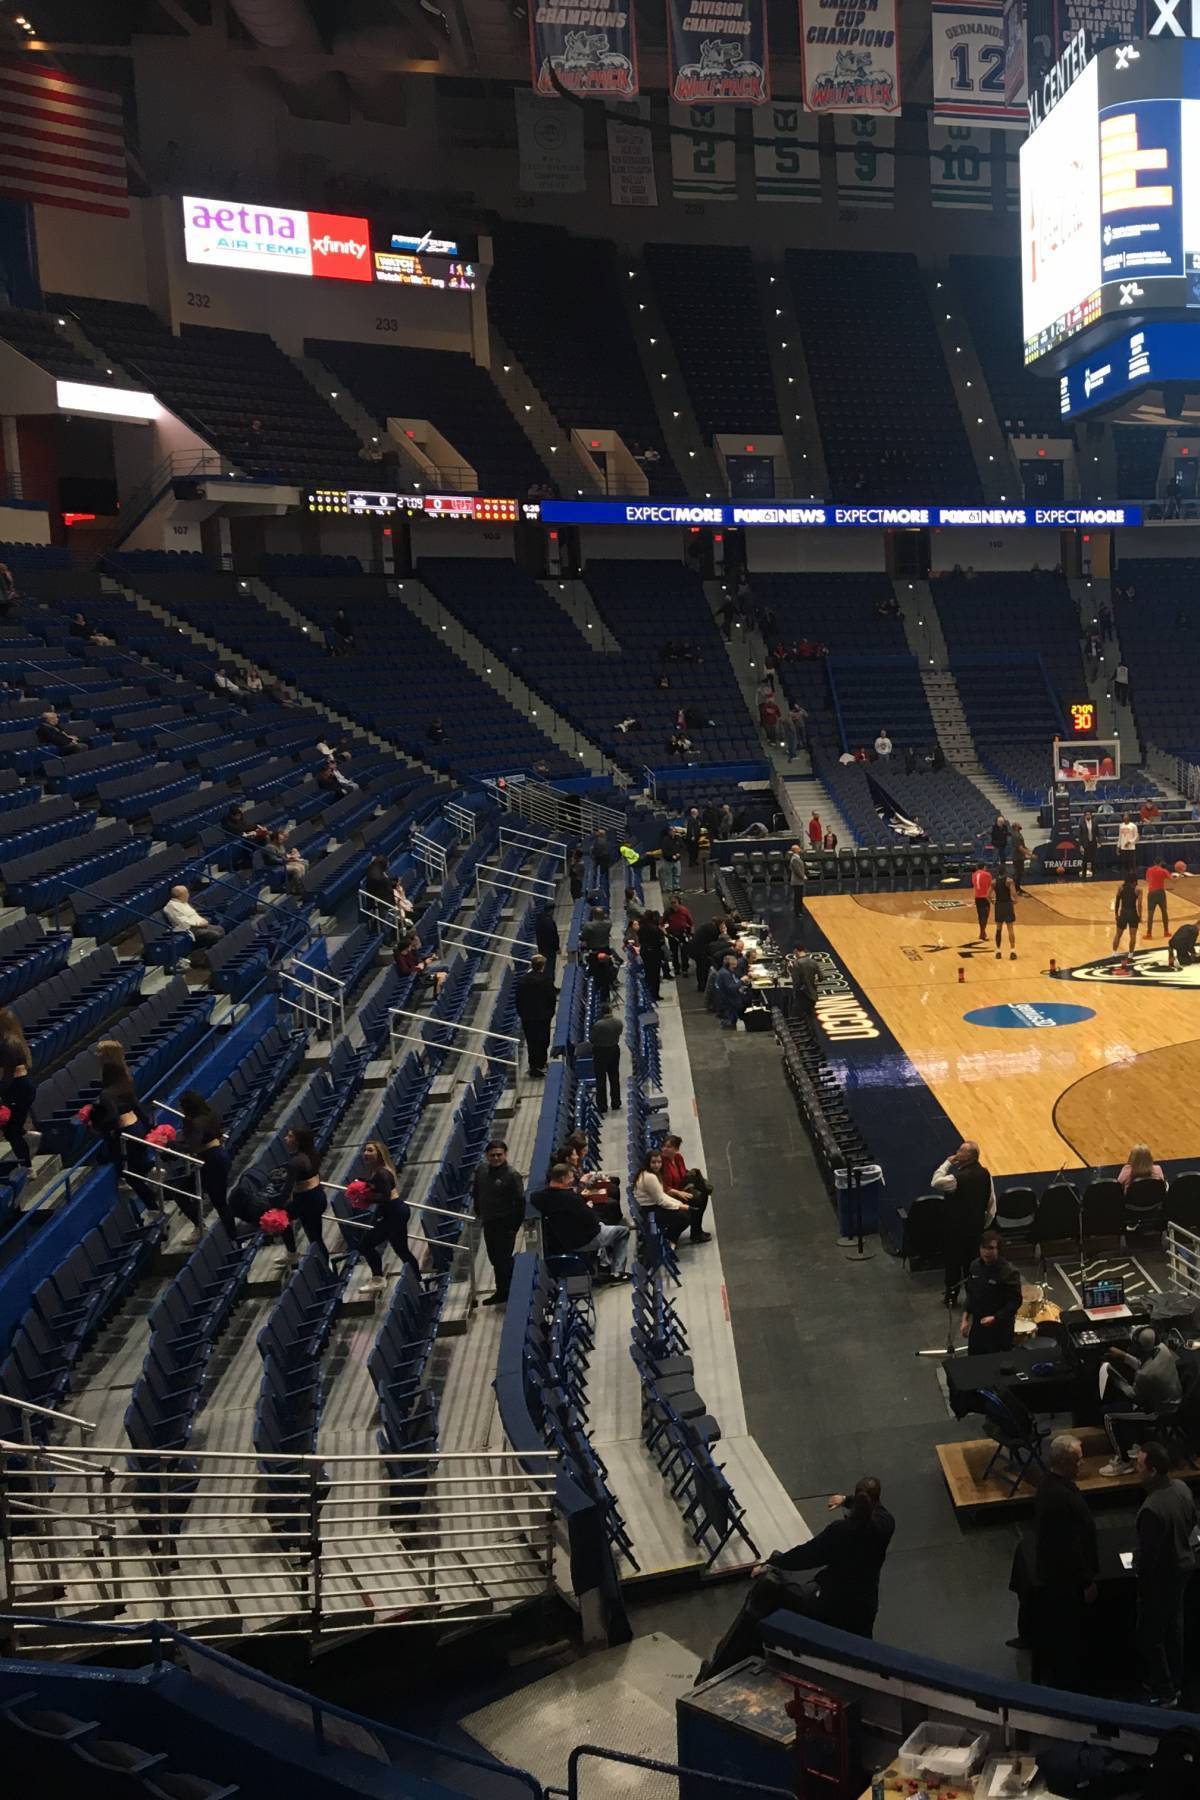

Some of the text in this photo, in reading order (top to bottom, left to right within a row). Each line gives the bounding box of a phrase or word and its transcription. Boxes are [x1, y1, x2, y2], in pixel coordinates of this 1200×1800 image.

[535, 8, 628, 28] CHAMPIONS
[690, 1, 744, 17] DIVISION
[1068, 7, 1135, 22] ATLANTIC
[682, 18, 752, 35] CHAMPIONS
[835, 11, 865, 28] CUP
[806, 26, 895, 48] CHAMPIONS
[1115, 45, 1140, 69] XL
[950, 43, 1006, 93] 12
[1027, 28, 1088, 137] XL CENTER
[775, 136, 800, 174] 5
[855, 141, 878, 182] 9
[941, 146, 981, 182] 10
[192, 204, 296, 239] aetna
[216, 237, 306, 255] AIR TEMP
[312, 235, 367, 260] xfinity
[187, 293, 210, 308] 232
[1120, 282, 1144, 305] XL
[375, 317, 399, 331] 233
[379, 496, 388, 506] 0
[433, 499, 442, 510] 0
[173, 526, 188, 535] 107
[1074, 714, 1091, 730] 30
